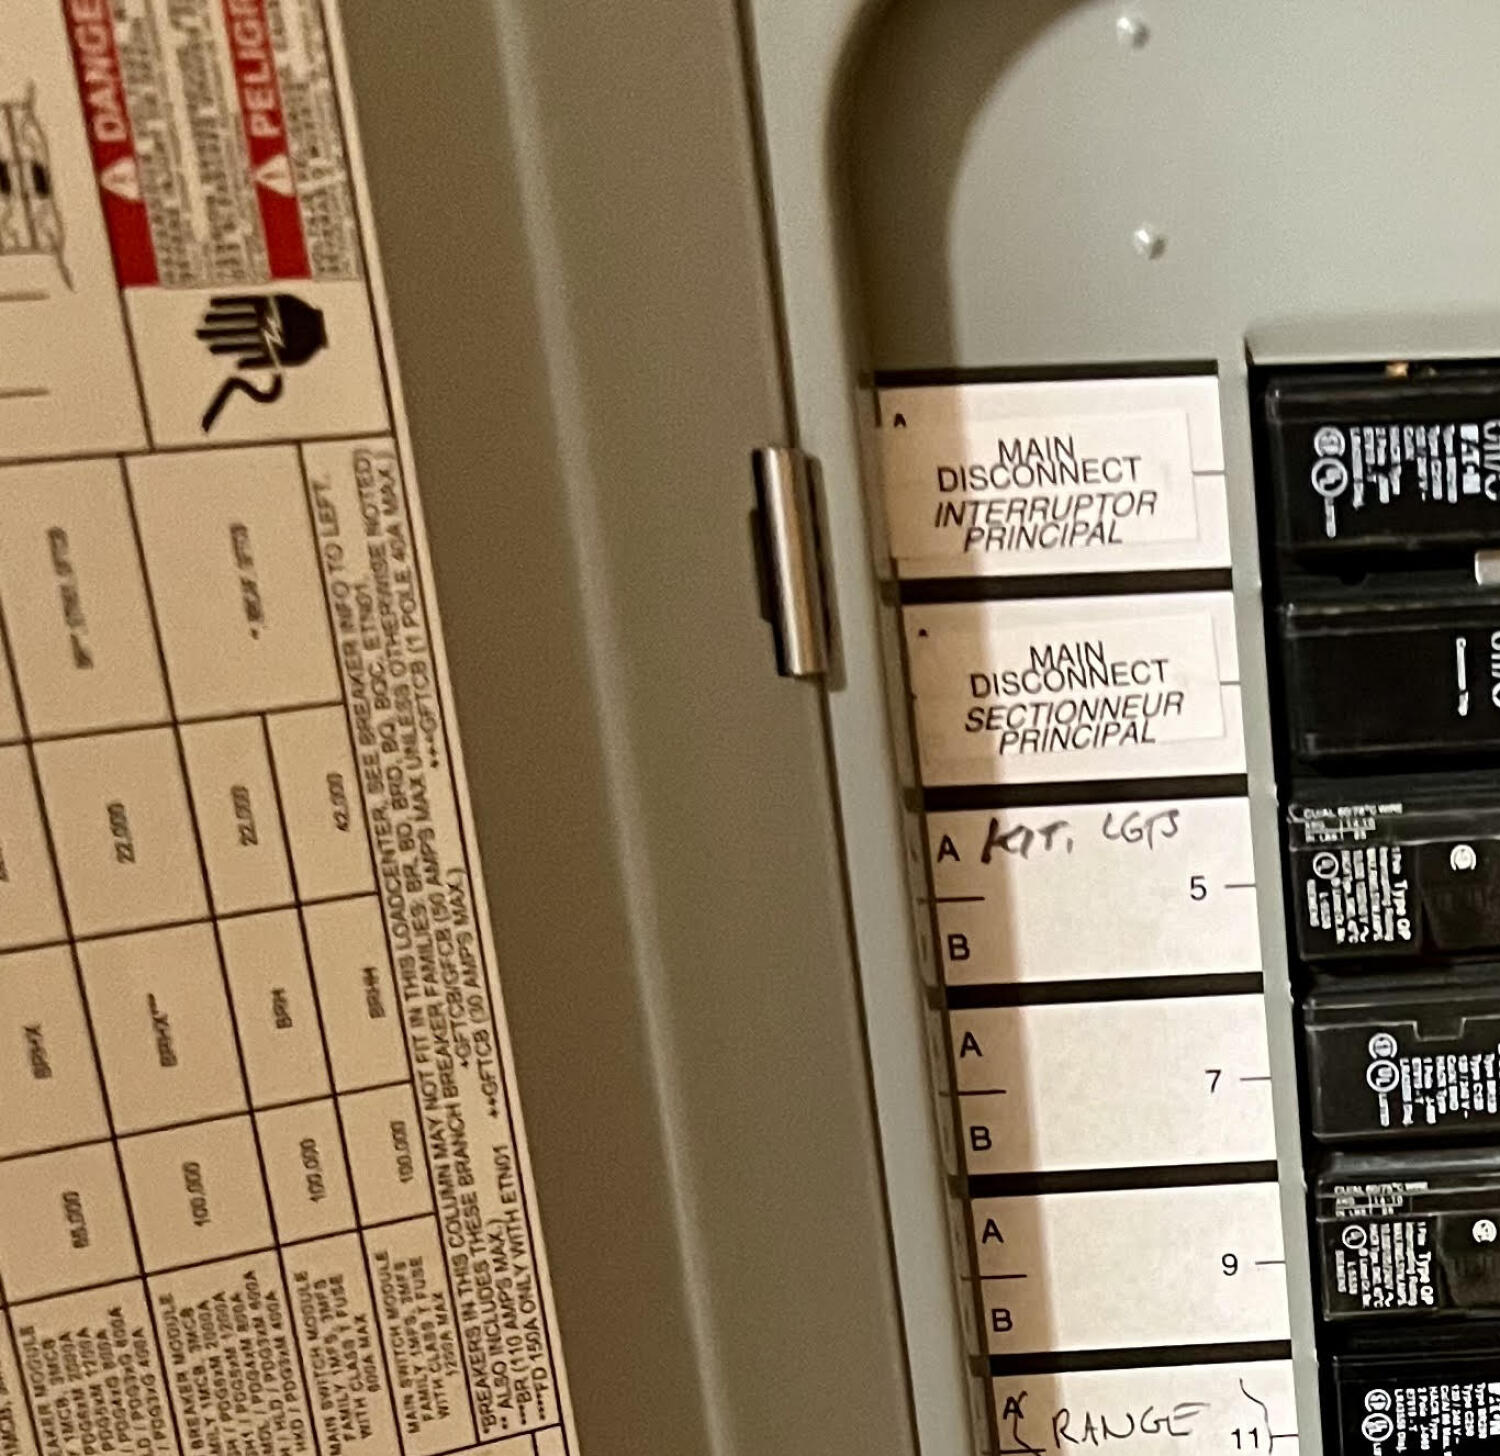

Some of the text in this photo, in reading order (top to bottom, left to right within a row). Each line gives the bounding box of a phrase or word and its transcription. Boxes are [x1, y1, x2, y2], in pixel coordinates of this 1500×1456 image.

[69, 0, 129, 141] DANGE
[229, 0, 282, 137] PELIG
[999, 435, 1075, 465] MAIN
[938, 456, 1142, 493] DISCONNECT
[935, 491, 1158, 527] INTERRUPTOR
[964, 519, 1122, 552] PRINCIPAL
[1030, 641, 1103, 670] MAIN
[971, 659, 1169, 698] DISCONNECT
[965, 692, 1183, 732] SECTIONNEUR
[1001, 719, 1155, 755] PRINCIPAL
[937, 835, 960, 863] A
[1191, 876, 1207, 900] 5
[948, 934, 970, 961] B
[960, 1032, 982, 1058] A
[1206, 1070, 1221, 1092] 7
[970, 1126, 992, 1151] B
[982, 1219, 1004, 1244] A
[1222, 1254, 1238, 1276] 9
[992, 1309, 1012, 1332] B
[1003, 1400, 1022, 1419] A
[1052, 1403, 1210, 1448] RANGE
[1232, 1428, 1258, 1449] 11
